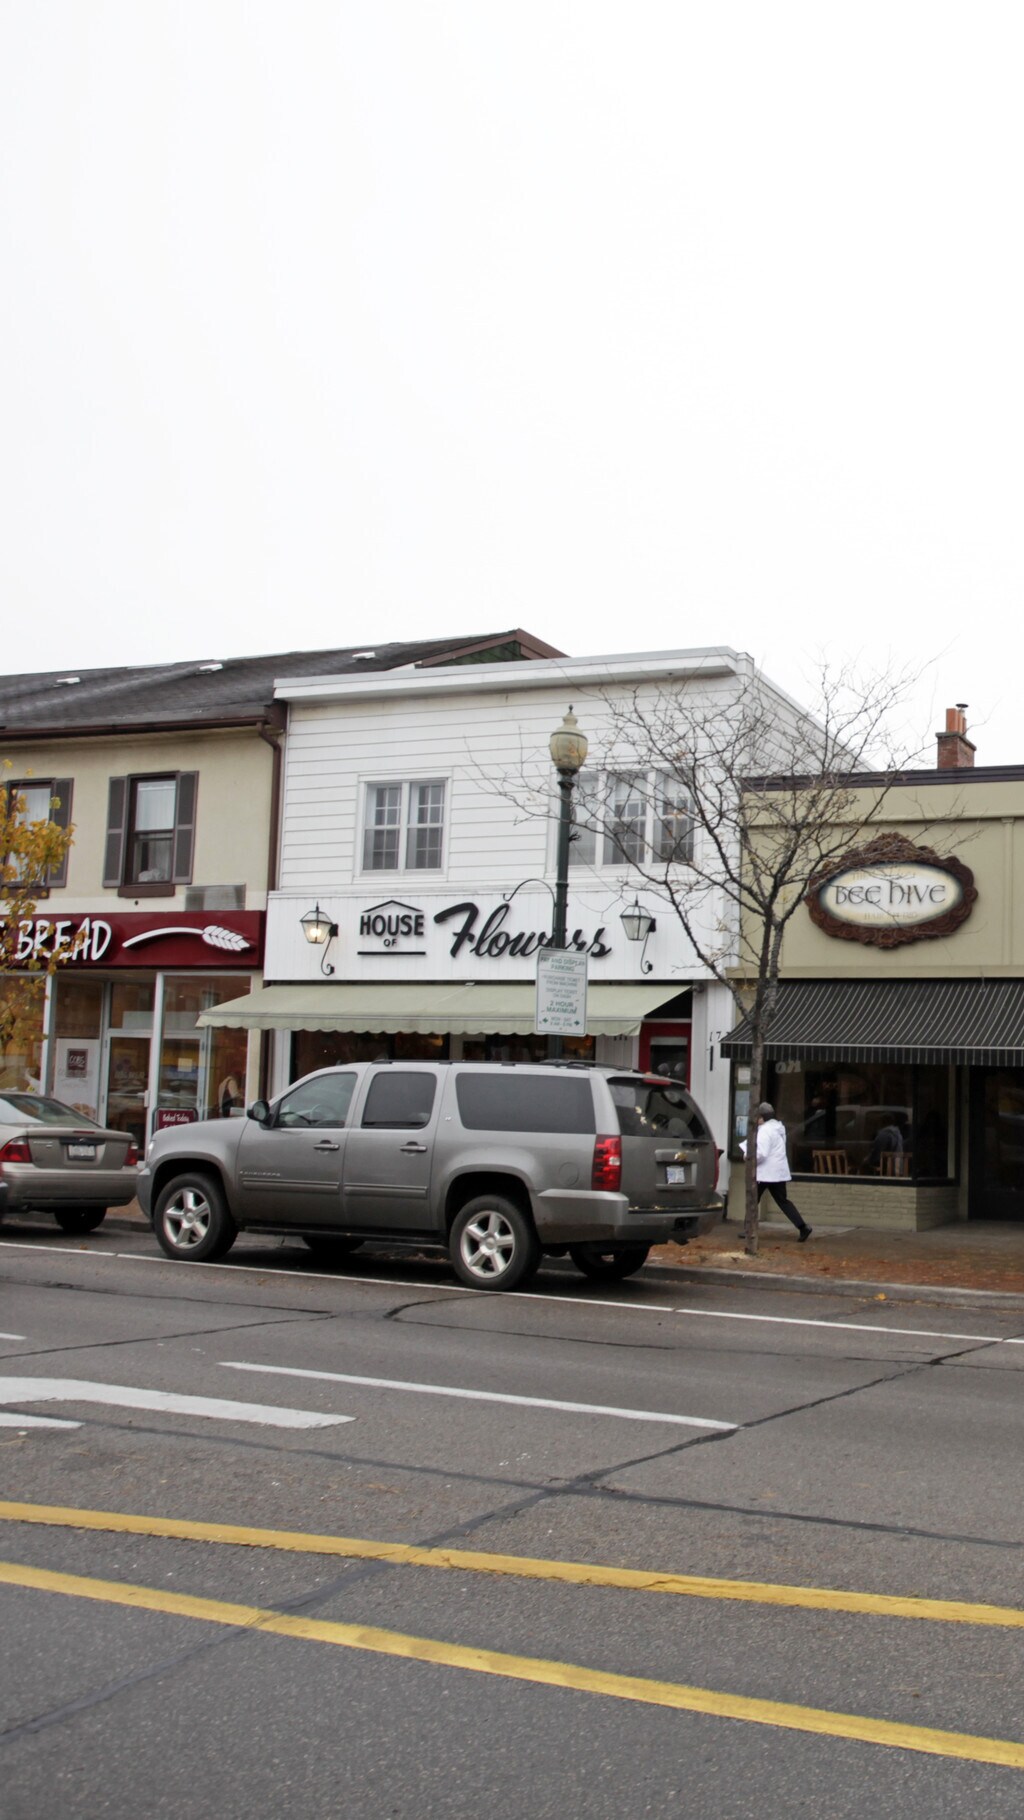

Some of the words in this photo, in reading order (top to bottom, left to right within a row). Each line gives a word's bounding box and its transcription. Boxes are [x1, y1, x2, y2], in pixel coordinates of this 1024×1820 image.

[360, 914, 425, 937] HOUSE
[433, 902, 613, 958] Flowrs
[15, 916, 112, 960] BREAD
[384, 938, 397, 947] OF
[546, 1007, 577, 1015] MAXIMUM
